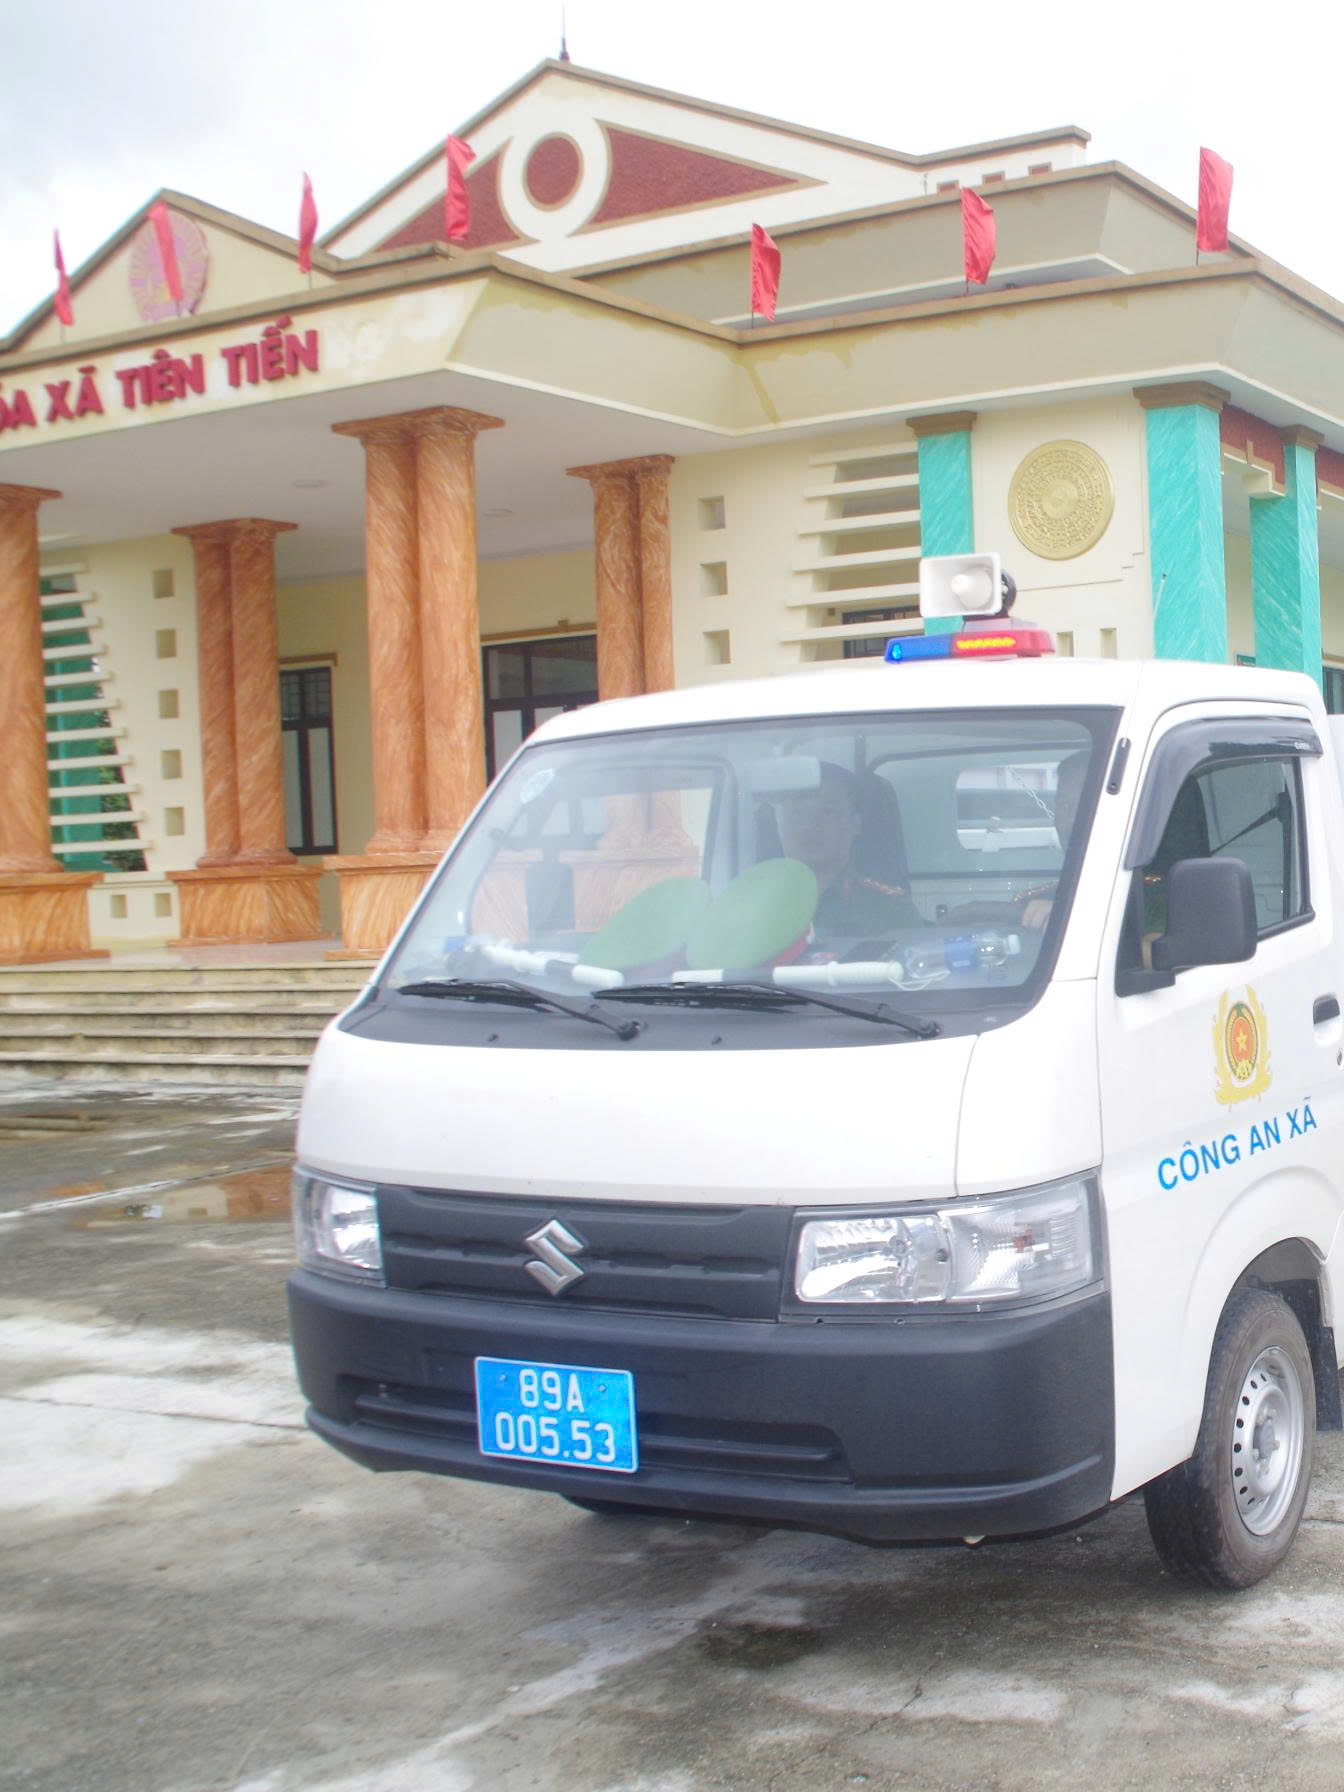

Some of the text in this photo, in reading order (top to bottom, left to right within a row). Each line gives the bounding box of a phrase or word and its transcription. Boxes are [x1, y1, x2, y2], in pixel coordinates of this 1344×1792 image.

[44, 365, 104, 422] XÃ
[115, 349, 206, 409] TIÊN
[220, 315, 319, 389] TIẾN
[1157, 1095, 1317, 1190] CÔNG AN XÃ
[519, 1369, 585, 1413] 89A
[495, 1411, 616, 1463] 005.53
